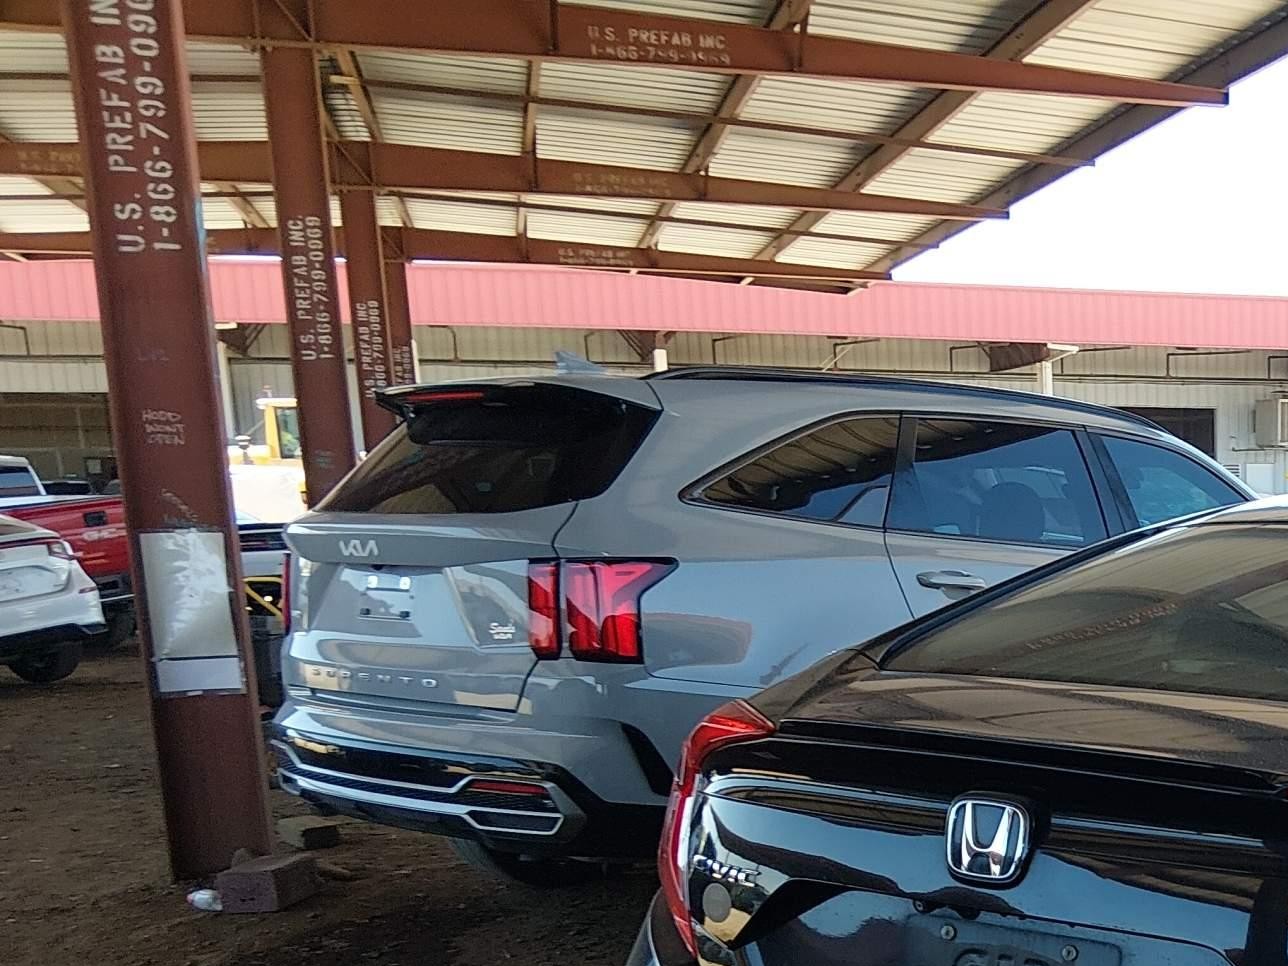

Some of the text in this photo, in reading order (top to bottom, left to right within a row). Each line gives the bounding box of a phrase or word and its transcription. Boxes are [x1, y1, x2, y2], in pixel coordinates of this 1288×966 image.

[628, 27, 692, 48] PREFAB
[94, 44, 139, 172] PREFAB
[113, 192, 145, 253] U.S.
[287, 215, 318, 361] U.S. PREFAB INC.
[338, 539, 379, 557] KIA
